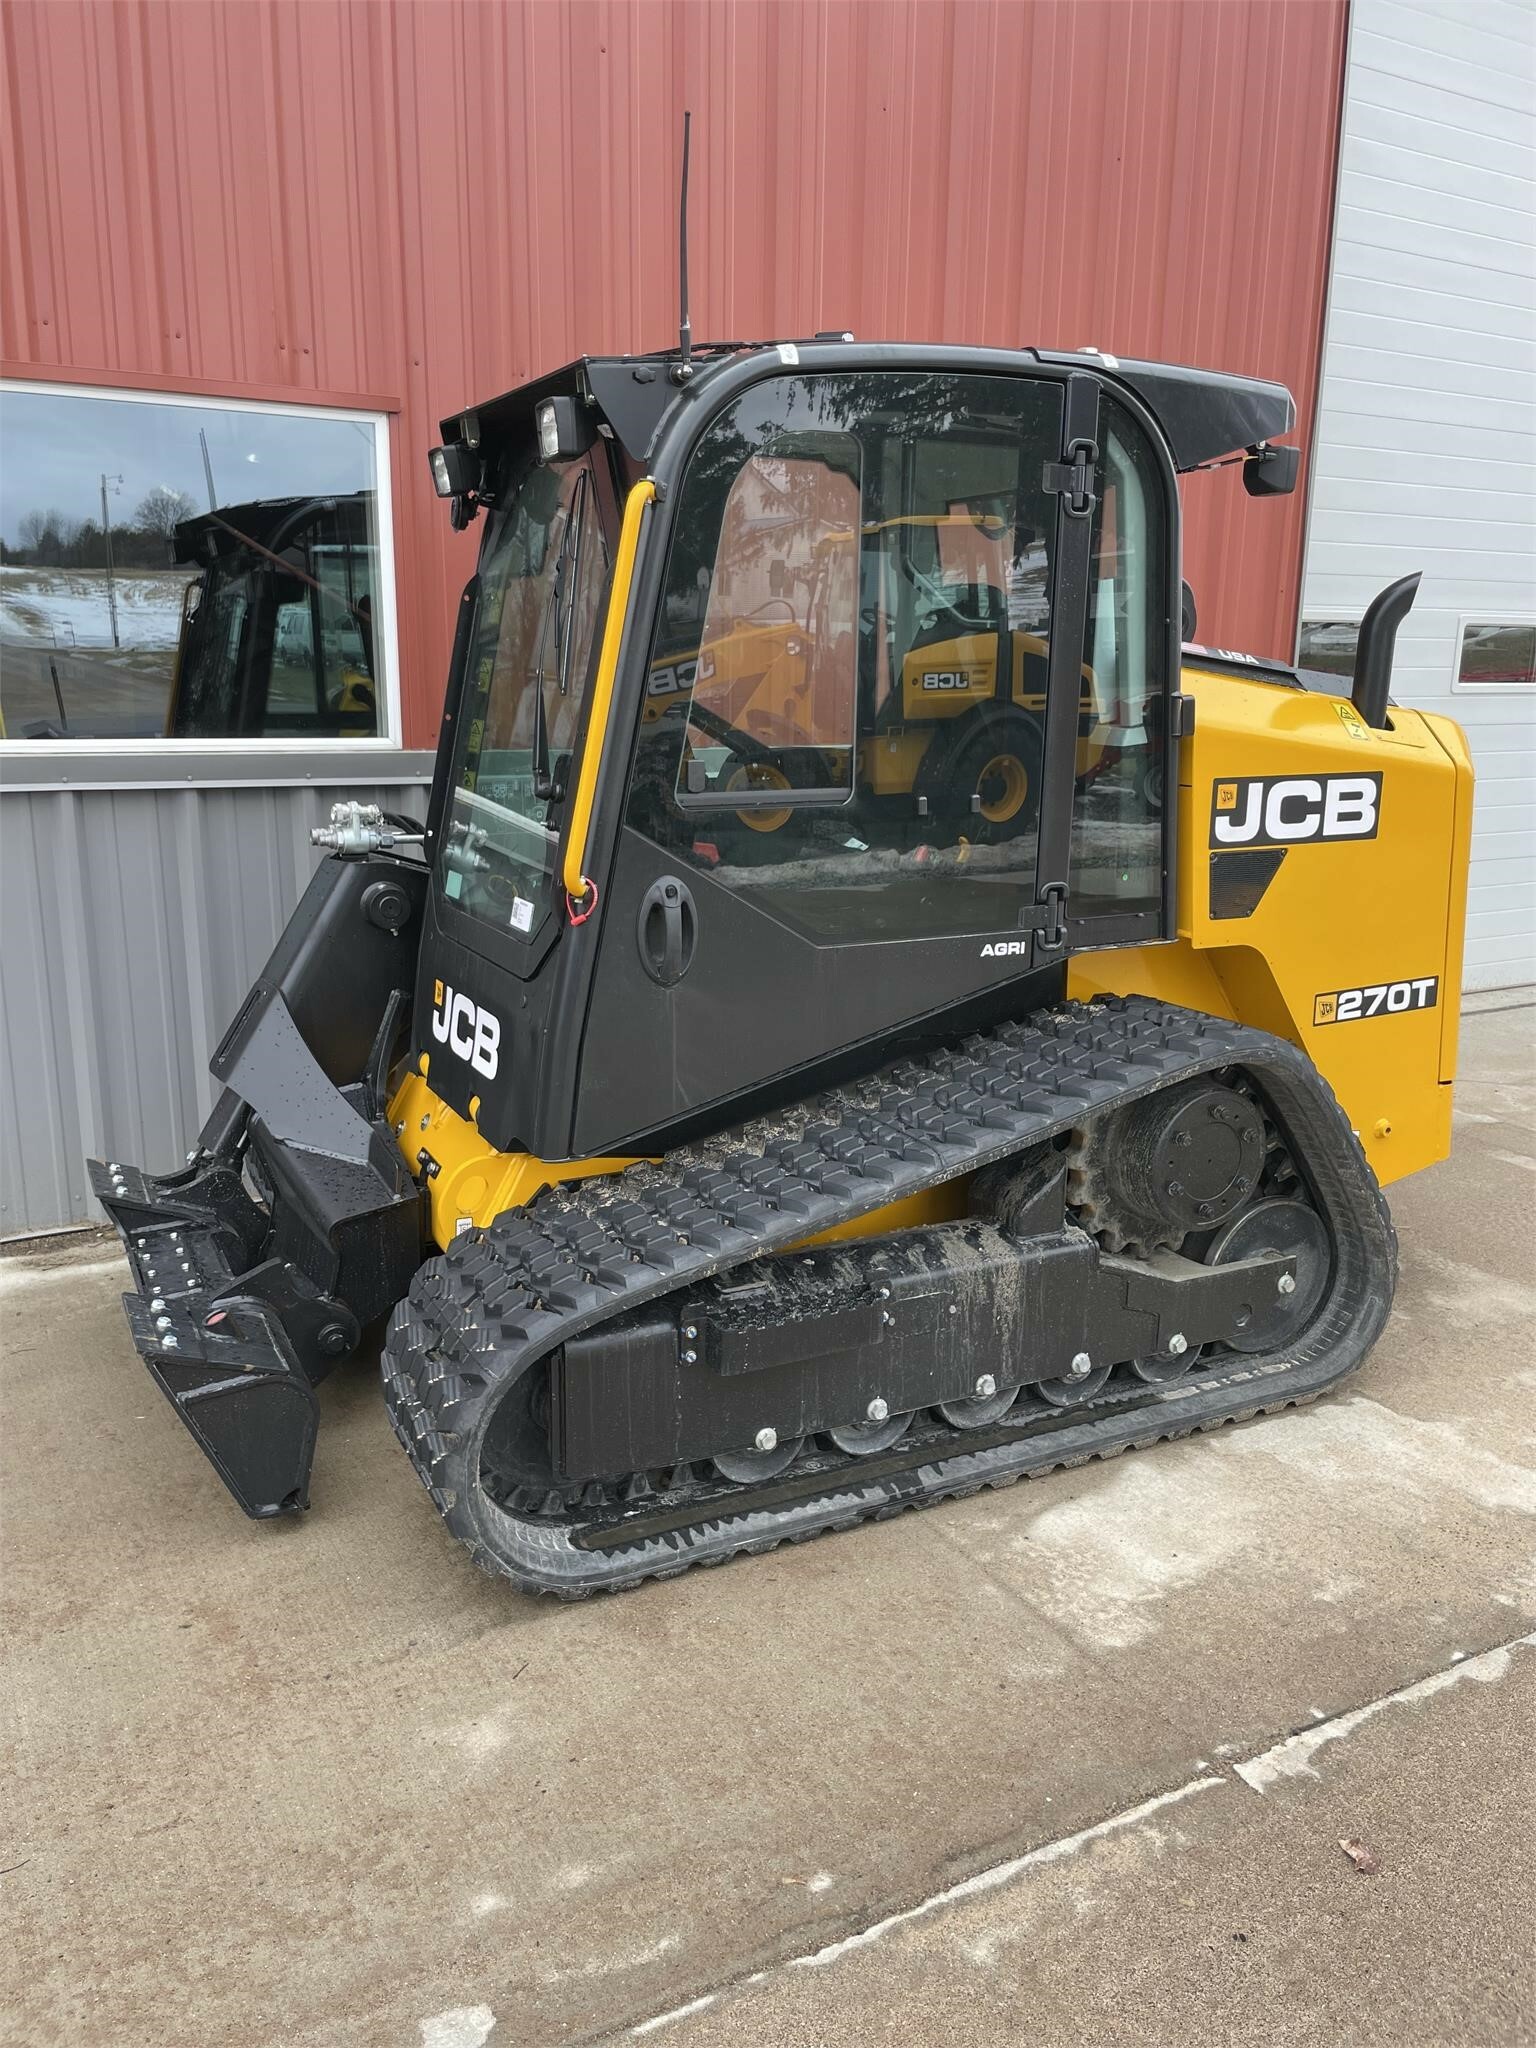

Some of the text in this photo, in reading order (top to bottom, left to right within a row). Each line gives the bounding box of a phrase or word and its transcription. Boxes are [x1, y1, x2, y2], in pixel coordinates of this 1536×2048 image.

[1217, 649, 1260, 664] USA
[1214, 778, 1378, 842] JCB
[980, 941, 1026, 957] AGRI
[1336, 978, 1435, 1021] 270T
[432, 985, 501, 1081] JCB
